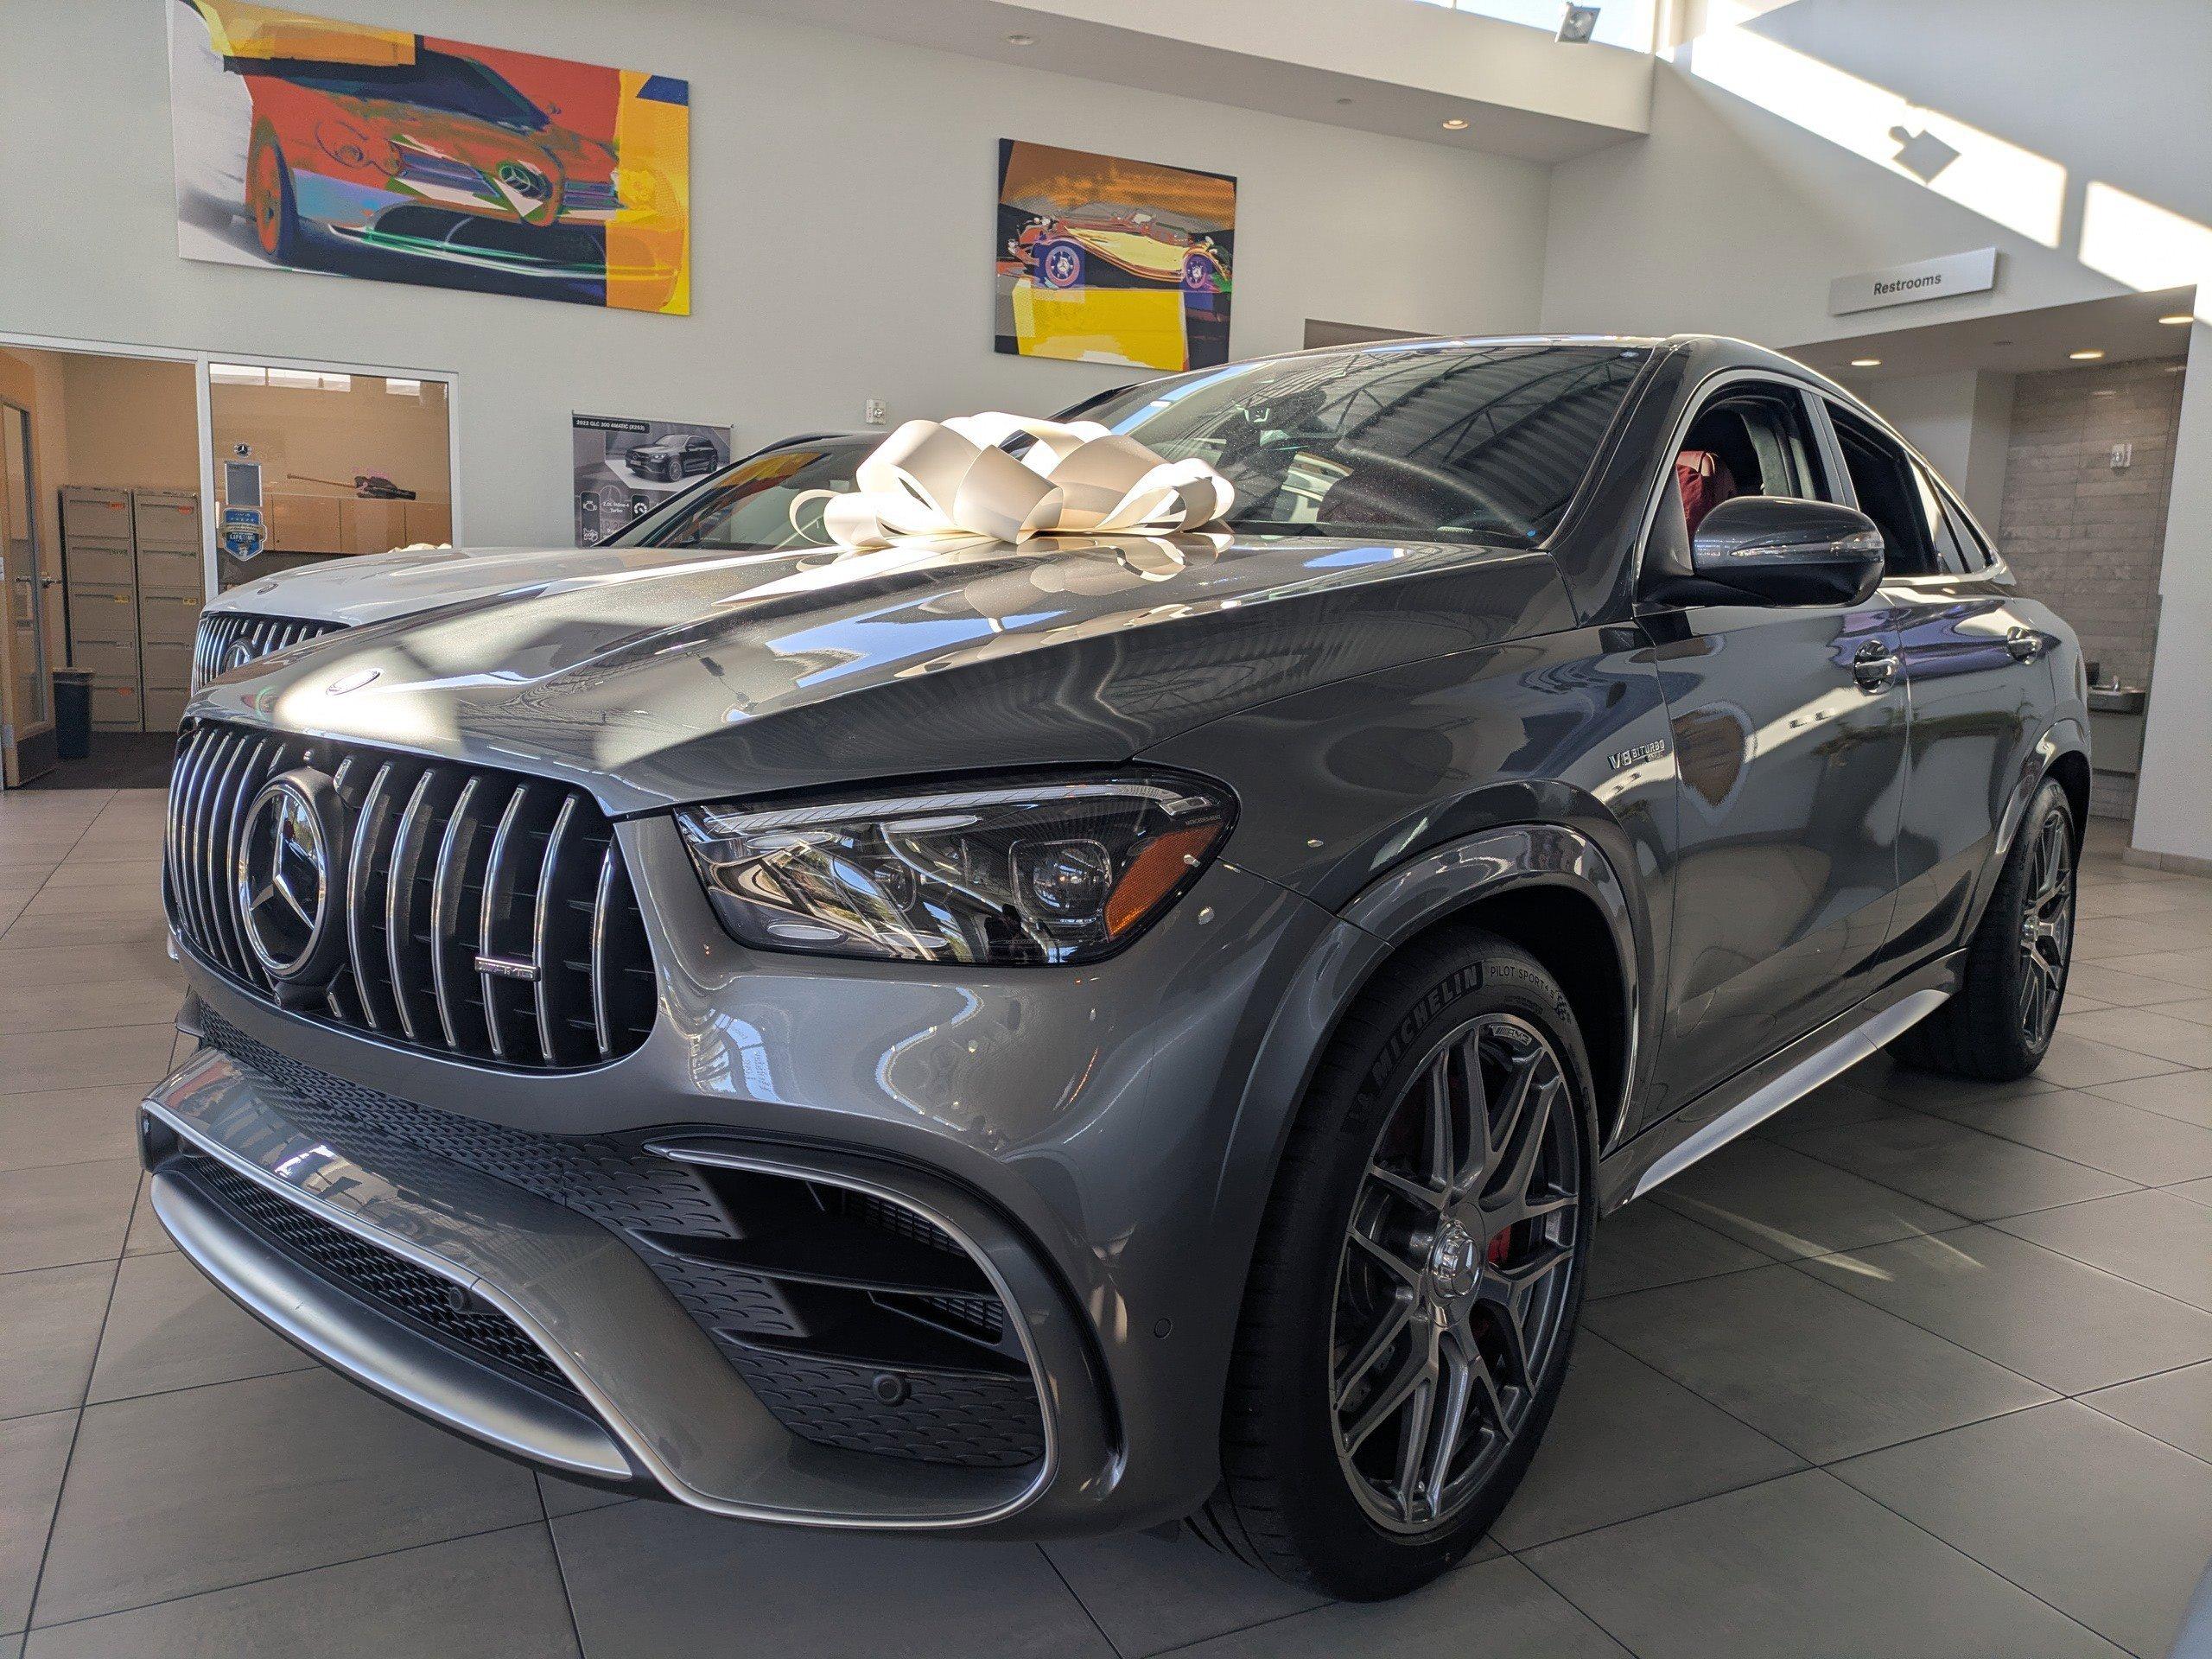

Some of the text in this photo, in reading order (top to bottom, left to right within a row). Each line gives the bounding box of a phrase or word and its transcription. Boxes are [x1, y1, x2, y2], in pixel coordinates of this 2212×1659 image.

[1873, 274, 1942, 296] Restrooms
[1608, 750, 1631, 770] V8
[1631, 739, 1665, 759] BITURBO
[1491, 965, 1516, 977] PILOT
[1518, 969, 1547, 990] SPORT
[1371, 966, 1479, 1080] MICHELIN
